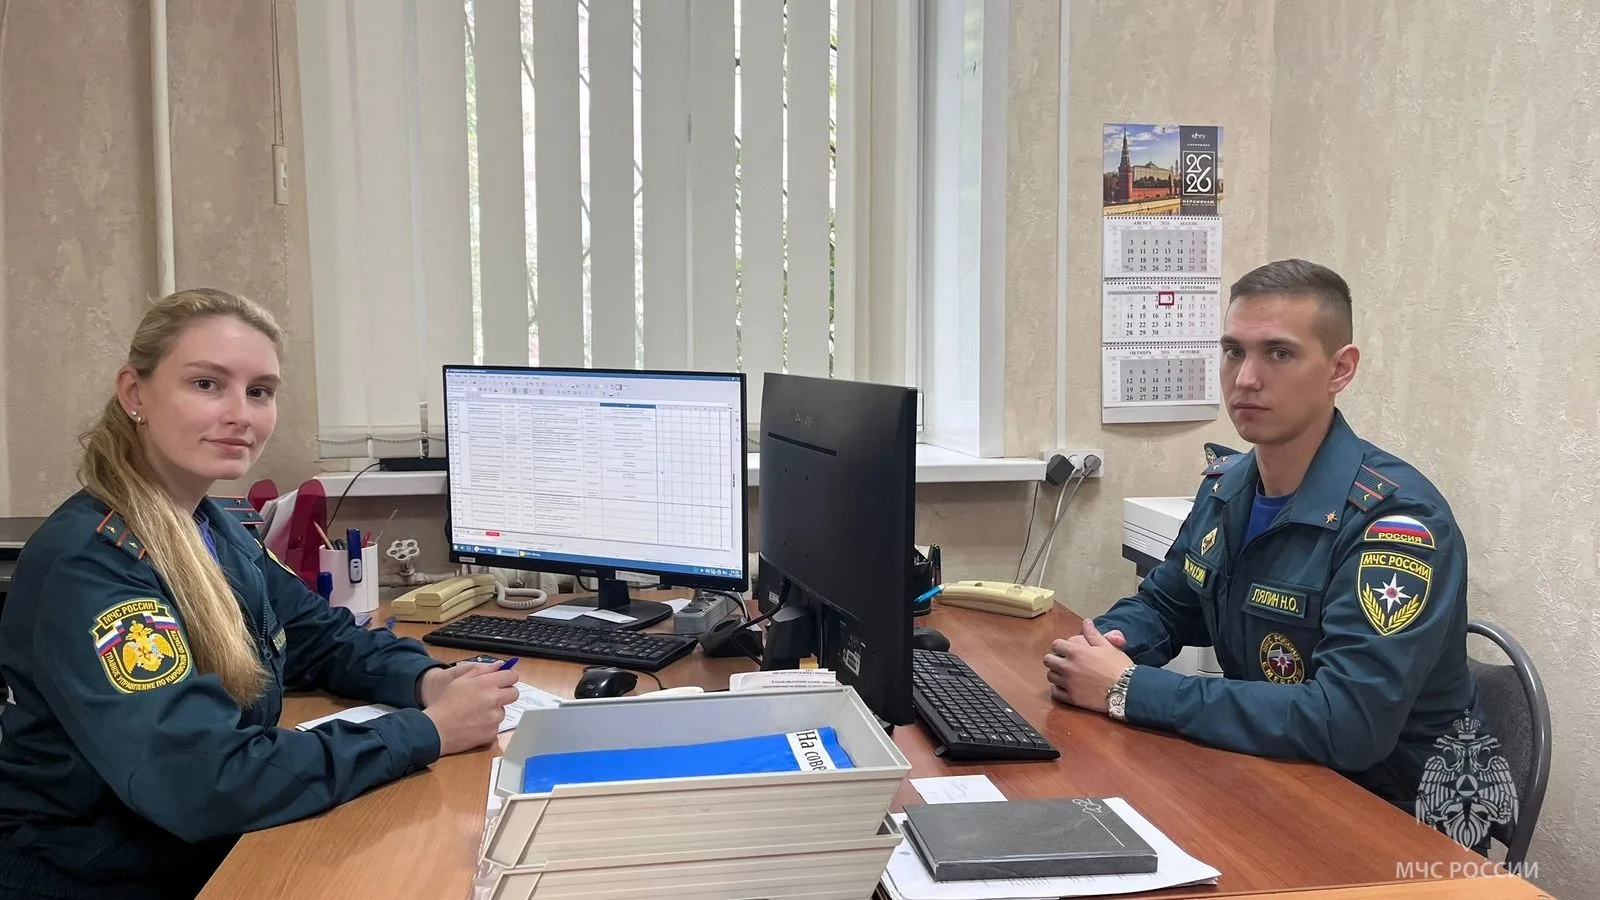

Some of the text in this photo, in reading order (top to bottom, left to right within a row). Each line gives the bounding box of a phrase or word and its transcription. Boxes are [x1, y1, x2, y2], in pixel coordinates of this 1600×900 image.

[1378, 532, 1422, 543] РОССИЯ
[1363, 554, 1430, 578] МЧС РОССИИ
[103, 602, 154, 625] МЧС РОССИИ
[796, 731, 818, 749] На
